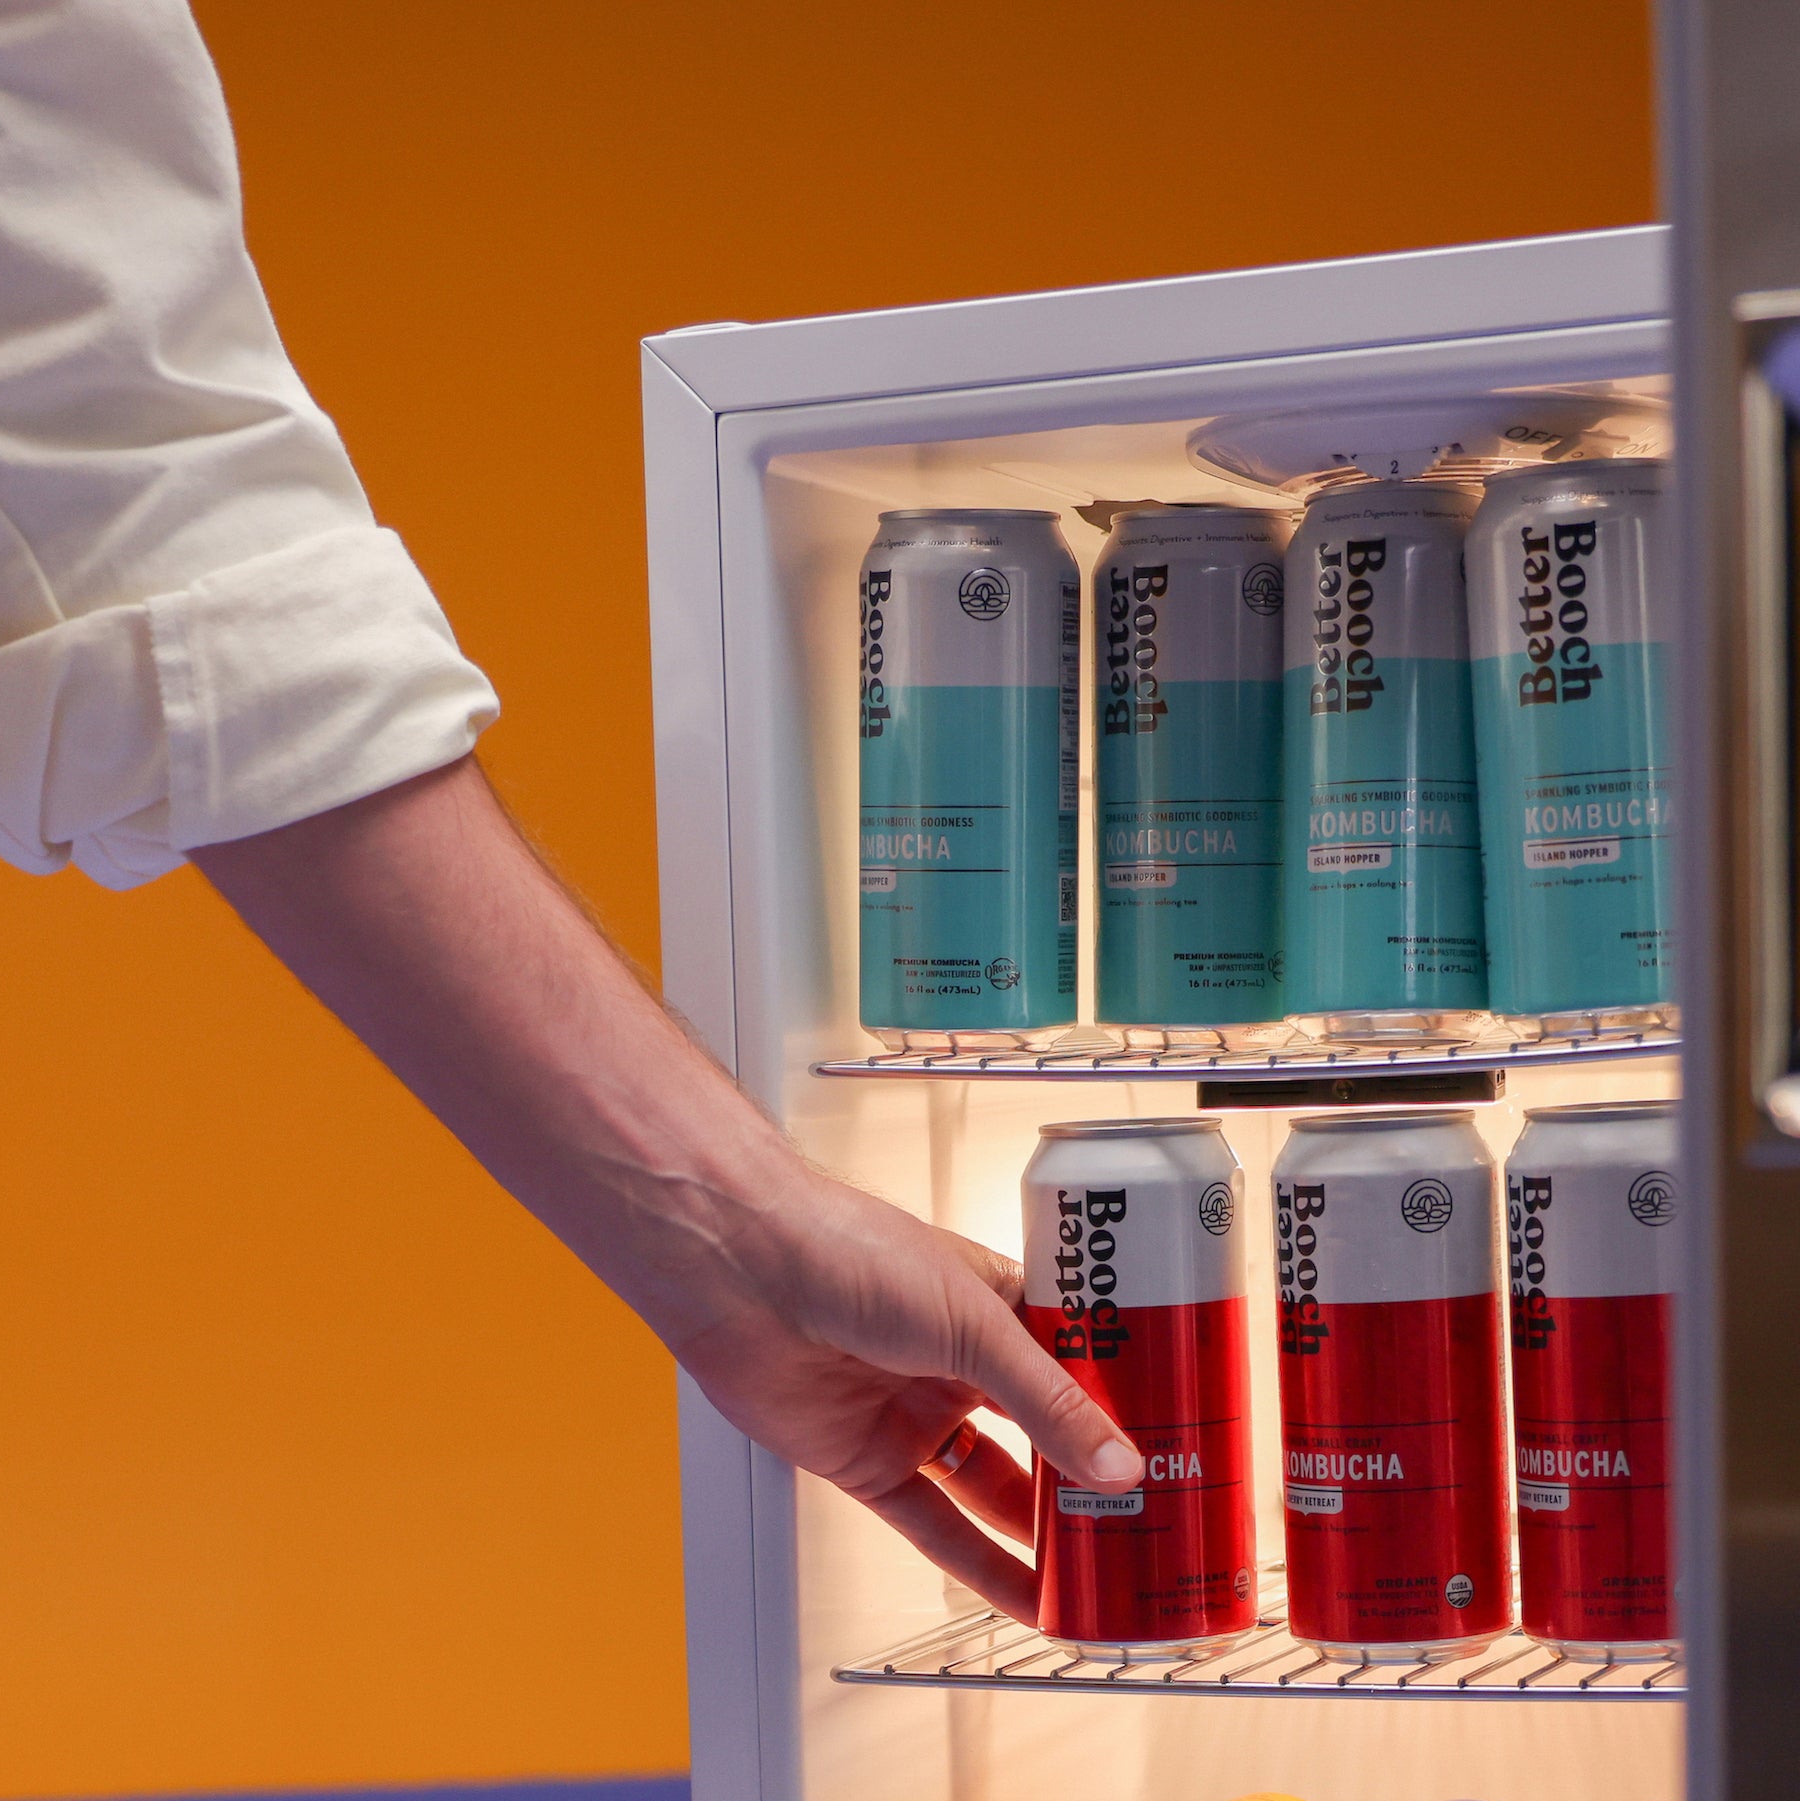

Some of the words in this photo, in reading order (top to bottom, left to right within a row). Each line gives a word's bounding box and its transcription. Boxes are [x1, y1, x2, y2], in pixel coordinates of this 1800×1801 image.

[1390, 460, 1399, 474] 2
[1363, 509, 1408, 521] Digestive
[1519, 527, 1557, 707] Better
[1554, 520, 1603, 703] Booch
[1310, 542, 1342, 717] Better
[1346, 537, 1387, 713] Booch
[869, 569, 892, 739] Booch
[1104, 567, 1130, 736] Better
[1133, 563, 1169, 735] Booch
[1525, 784, 1581, 800] SPARKLING
[1585, 781, 1643, 795] SYMBIOTIC
[921, 817, 974, 828] GOODNESS
[1147, 811, 1201, 823] SYMBIOTIC
[1205, 811, 1259, 822] GOODNESS
[1310, 808, 1453, 839] KOMBUCHA
[1106, 829, 1236, 855] KOMBUCHA
[1314, 855, 1341, 866] ISLAND
[1344, 853, 1381, 864] HOPPER
[1534, 850, 1566, 862] ISLAND
[1569, 848, 1609, 859] HOPPER
[1134, 872, 1166, 881] HOPPER
[1366, 880, 1396, 889] oolong
[893, 958, 928, 967] PREMIUM
[930, 958, 980, 967] KOMBUCHA
[1173, 953, 1214, 961] PREMIUM
[925, 970, 981, 978] UNPASTEURIZED
[905, 985, 914, 994] 16
[938, 985, 981, 995] (473mL)
[1189, 980, 1199, 988] 16
[1225, 979, 1265, 988] (473mL)
[1277, 1183, 1297, 1353] Better
[1294, 1184, 1329, 1354] Booch
[1523, 1176, 1557, 1349] Booch
[1055, 1190, 1087, 1360] Better
[1086, 1188, 1131, 1360] Booch
[1147, 1437, 1184, 1449] CRAFT
[1346, 1437, 1382, 1449] CRAFT
[1063, 1499, 1092, 1509] CHERRY
[1096, 1499, 1136, 1509] RETREAT
[1305, 1497, 1336, 1508] RETREAT
[1533, 1493, 1562, 1504] RETREAT
[1177, 1571, 1229, 1586] ORGANIC
[1376, 1576, 1438, 1588] ORGANIC
[1602, 1576, 1665, 1587] ORGANIC
